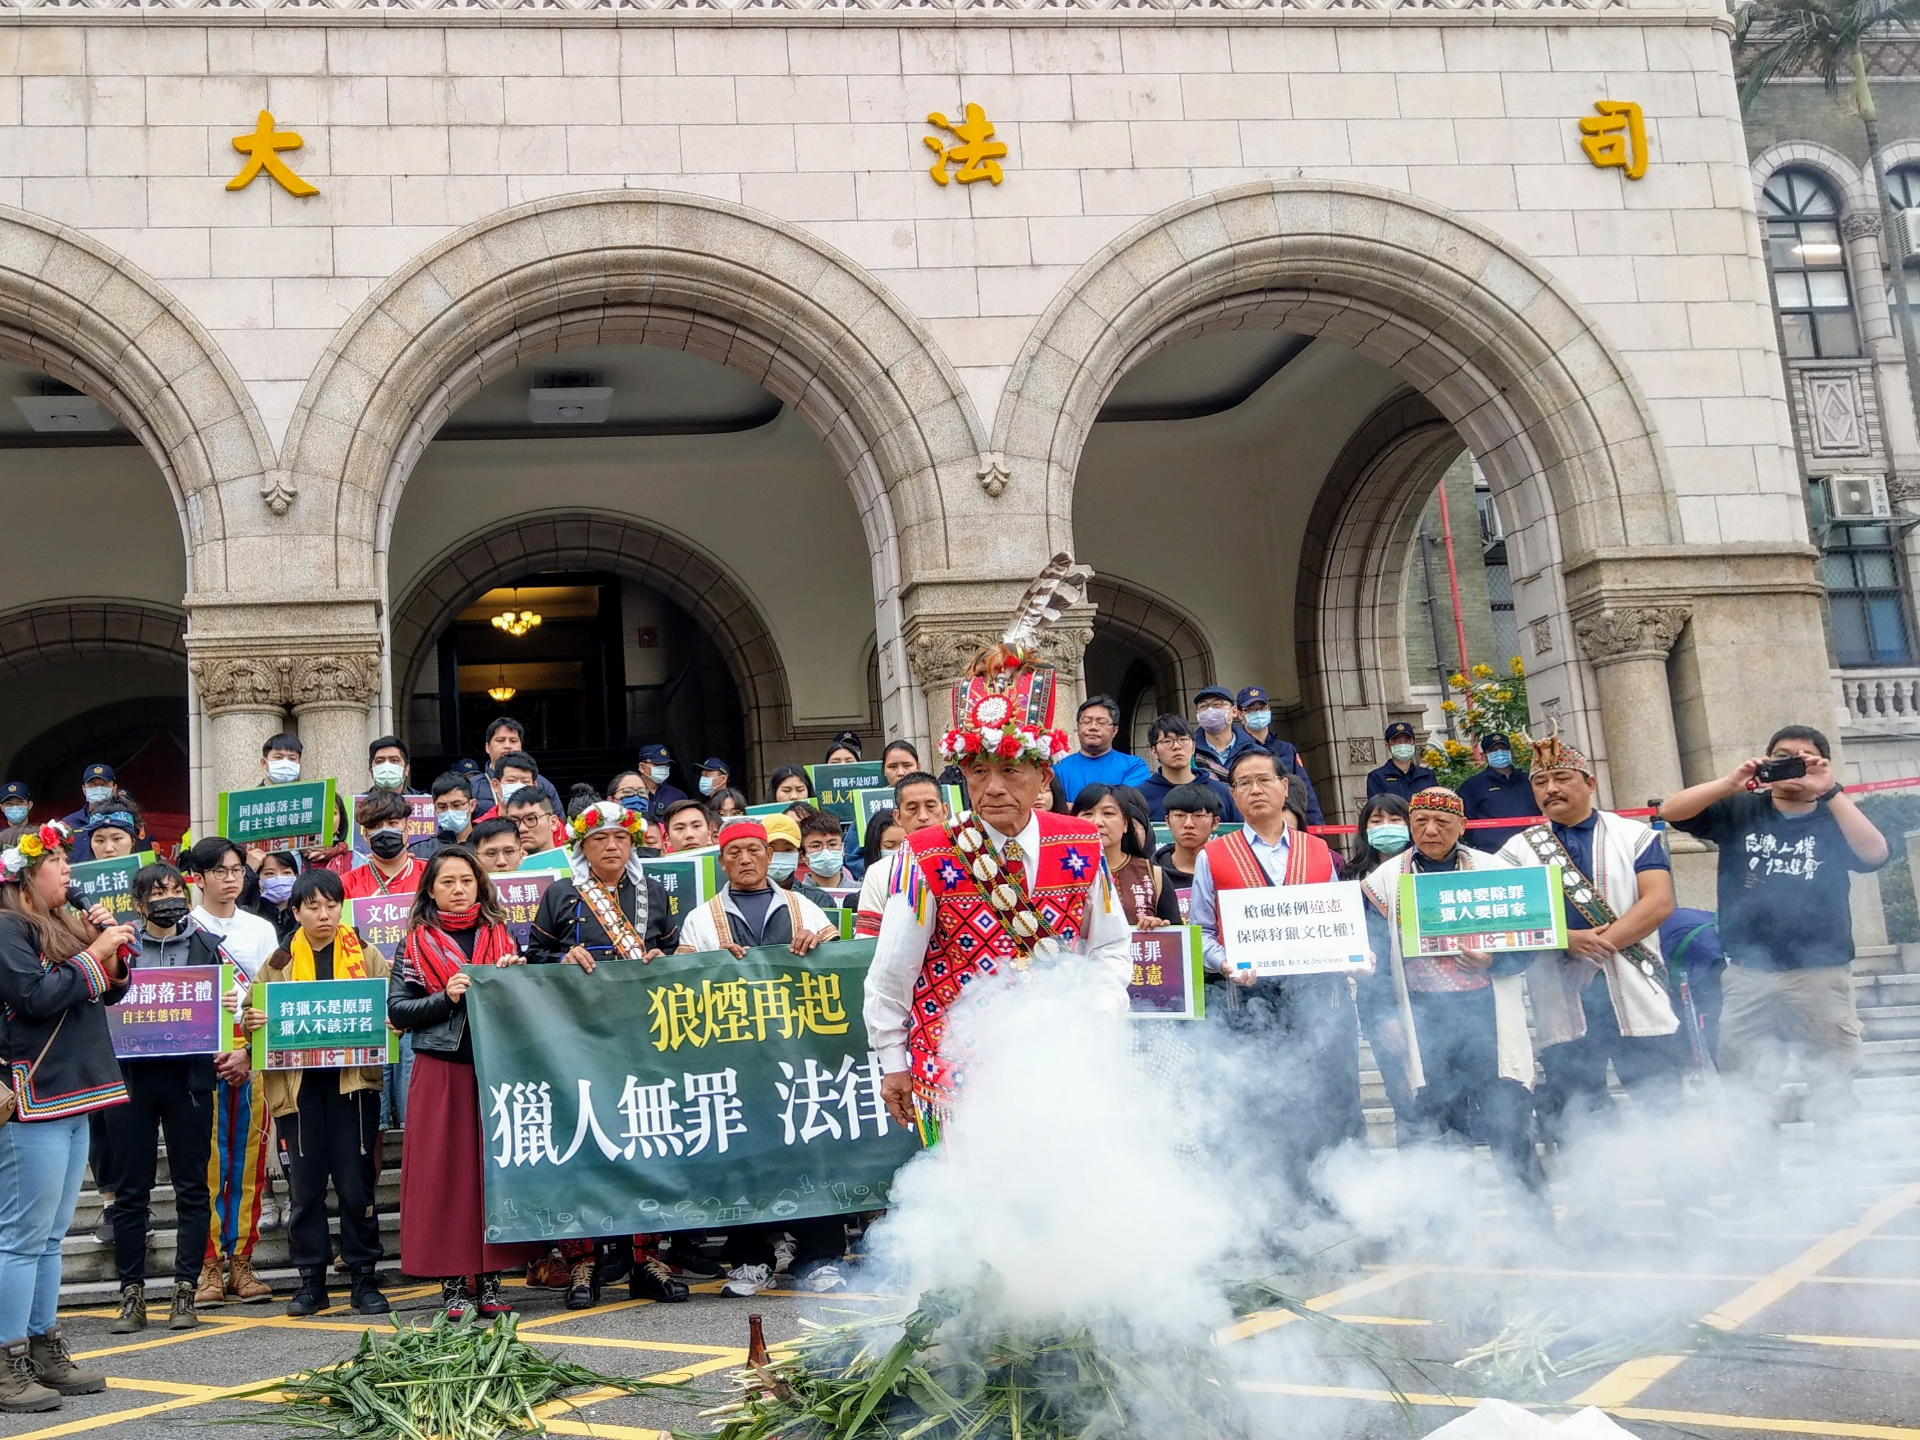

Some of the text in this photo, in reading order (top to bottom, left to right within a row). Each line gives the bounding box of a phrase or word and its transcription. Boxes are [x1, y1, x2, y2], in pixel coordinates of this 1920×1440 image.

[225, 100, 1648, 197] 大 法 司
[832, 776, 880, 788] 狩獵不是原罪
[239, 797, 313, 818] 回歸部落主體
[239, 811, 313, 832] 自主生態管理
[1438, 884, 1526, 905] 獵槍要除罪
[1244, 899, 1343, 919] 槍砲條例違憲
[1440, 902, 1528, 923] 獵人要回家
[122, 1008, 192, 1024] 自主生態管理
[280, 998, 373, 1017] 狩獵不是原罪
[647, 971, 849, 1052] 狼煙再起
[489, 1067, 748, 1168] 獵人無罪
